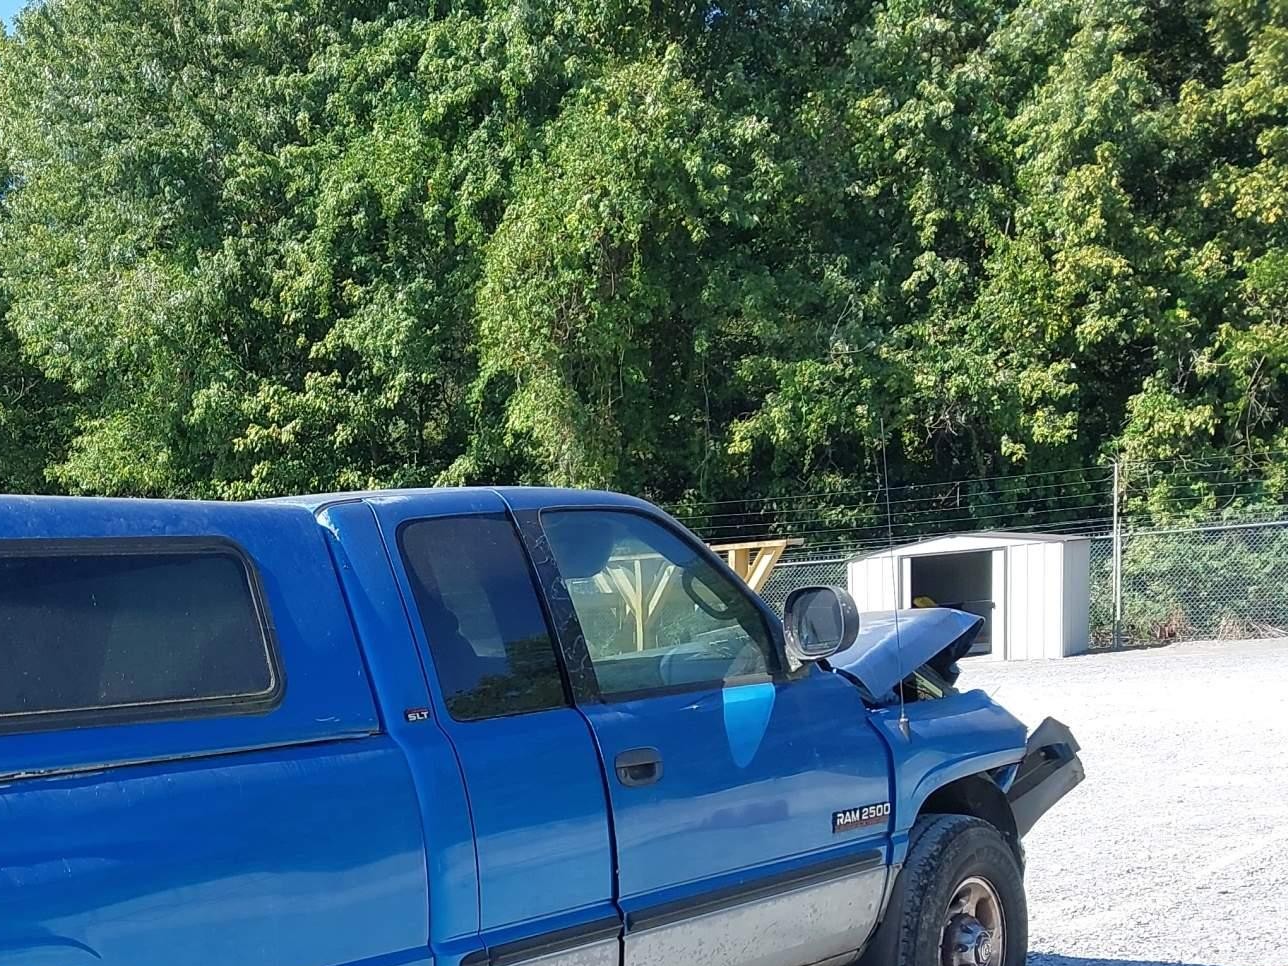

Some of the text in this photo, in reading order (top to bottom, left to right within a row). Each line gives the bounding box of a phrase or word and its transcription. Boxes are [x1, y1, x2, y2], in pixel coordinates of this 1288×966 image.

[407, 711, 429, 721] SLT
[836, 803, 891, 826] RAM 2500
